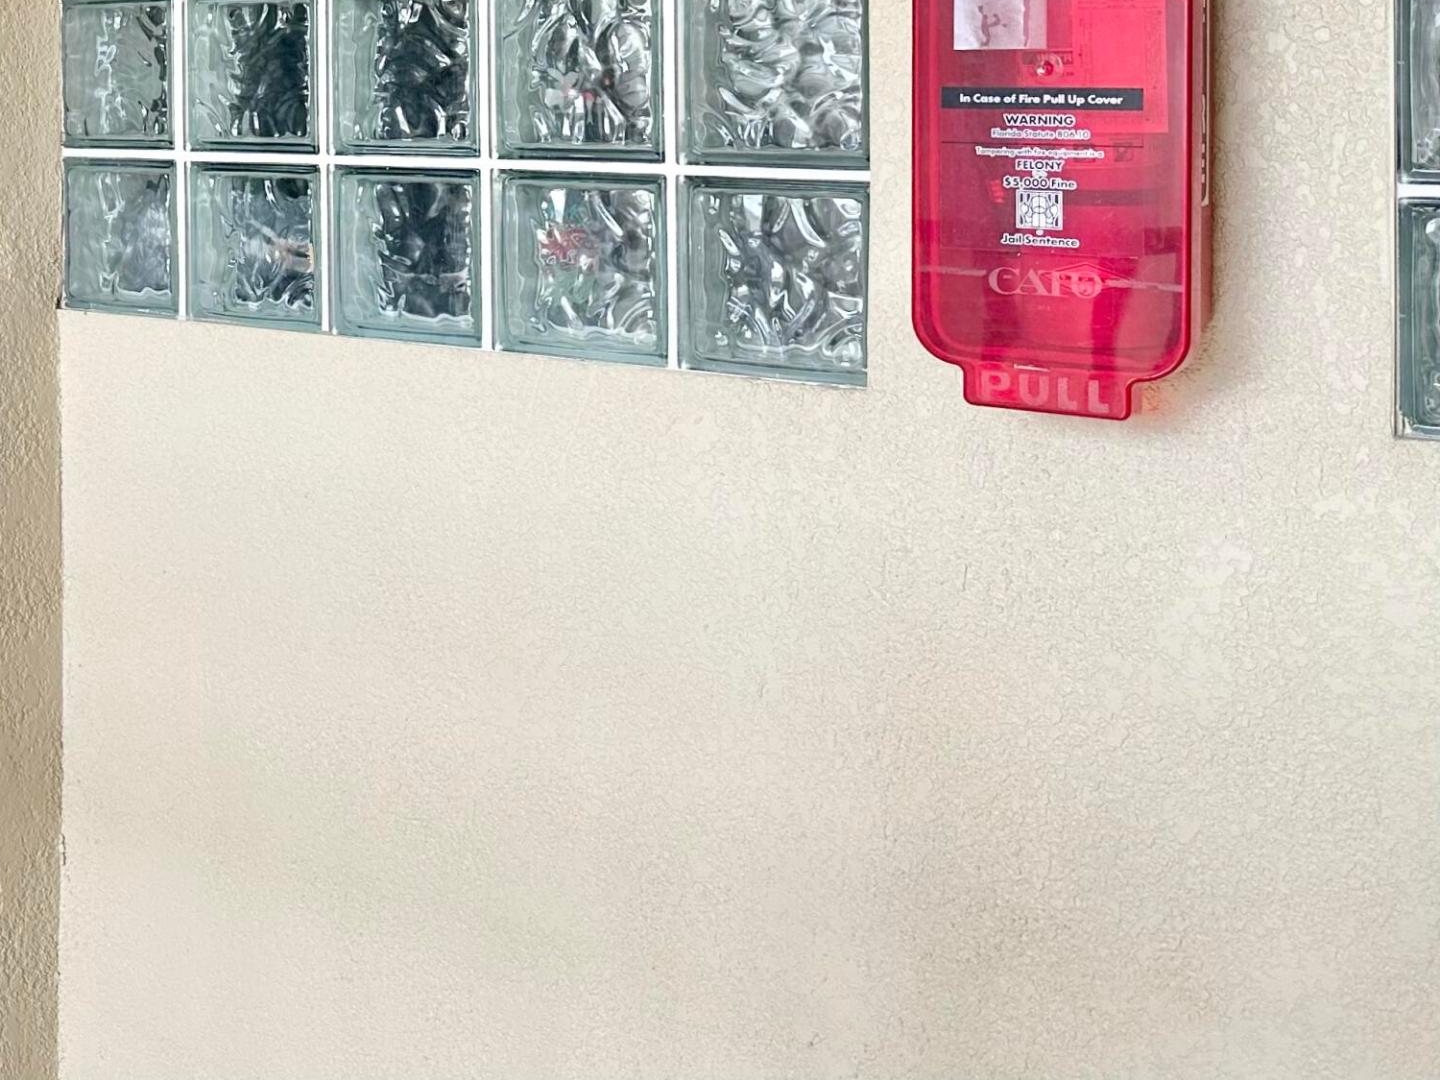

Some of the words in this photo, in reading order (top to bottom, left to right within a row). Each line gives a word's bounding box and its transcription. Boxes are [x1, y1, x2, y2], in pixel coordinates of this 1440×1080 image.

[959, 93, 971, 103] In
[973, 93, 1001, 104] Case
[1003, 94, 1017, 104] of
[1018, 94, 1041, 104] Fire
[1043, 94, 1065, 104] Pull
[1067, 94, 1085, 107] Up
[1087, 94, 1123, 105] Cover
[1004, 114, 1075, 126] WARNING
[991, 128, 1021, 138] Florida
[1023, 129, 1055, 139] Statute
[1017, 160, 1062, 170] FELONY
[1051, 178, 1076, 189] Fine
[1001, 233, 1023, 244] Jail
[1024, 235, 1079, 247] Sentence
[981, 371, 1109, 412] PULL
